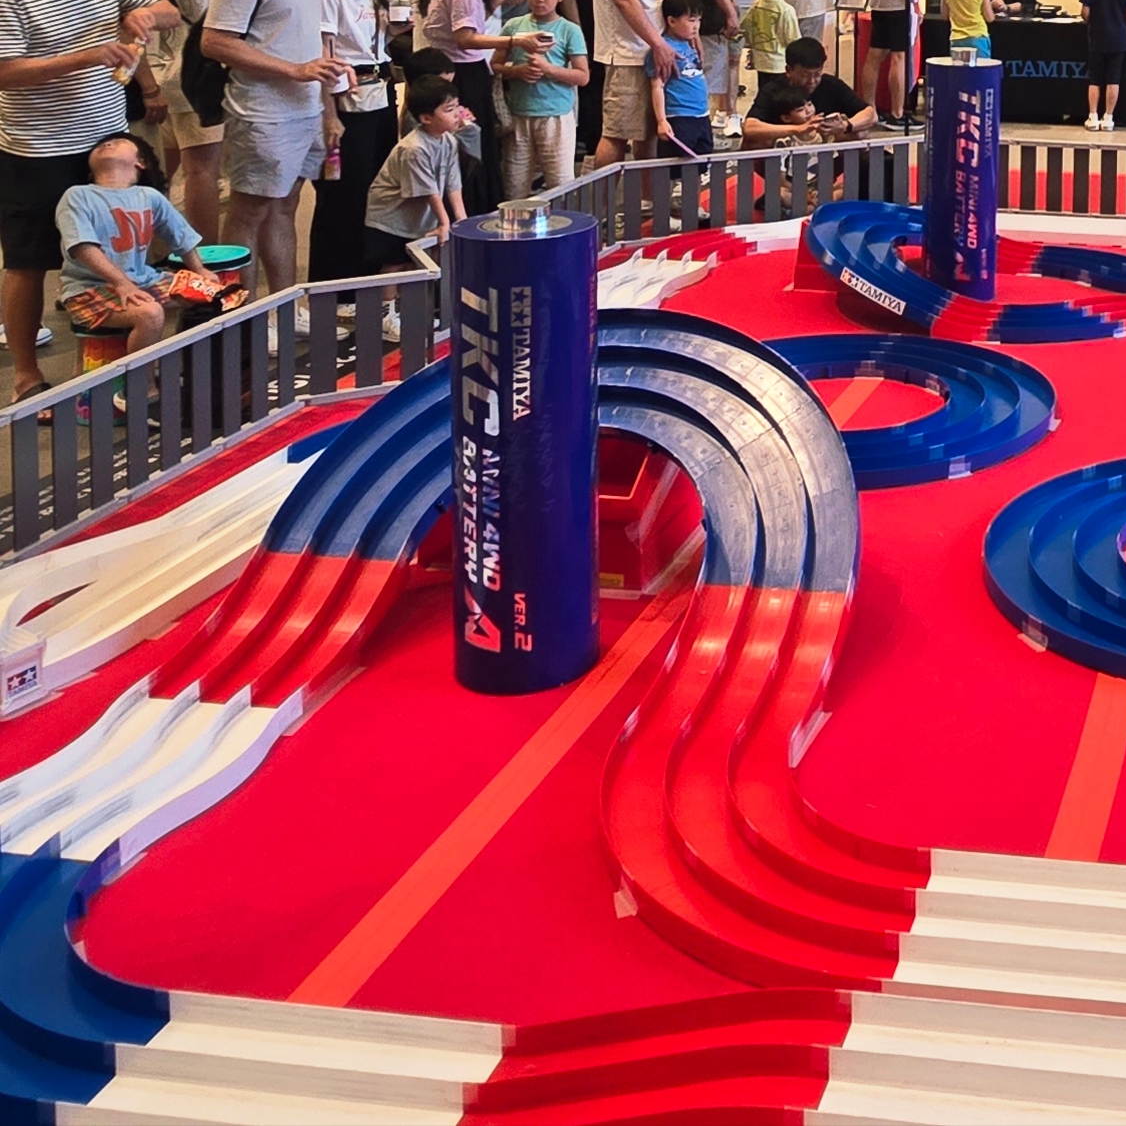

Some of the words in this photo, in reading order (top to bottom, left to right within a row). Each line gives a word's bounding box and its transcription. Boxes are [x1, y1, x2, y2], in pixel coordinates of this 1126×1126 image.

[955, 89, 981, 168] TKC
[968, 174, 980, 211] MINI
[966, 212, 979, 250] 4WD
[860, 280, 901, 312] TAMIYA
[461, 286, 500, 437] TKC
[512, 327, 531, 421] TAMIYA
[462, 435, 478, 584] BATTERY
[482, 447, 500, 517] MINI
[482, 521, 500, 592] 4WD
[514, 592, 532, 652] VER.2
